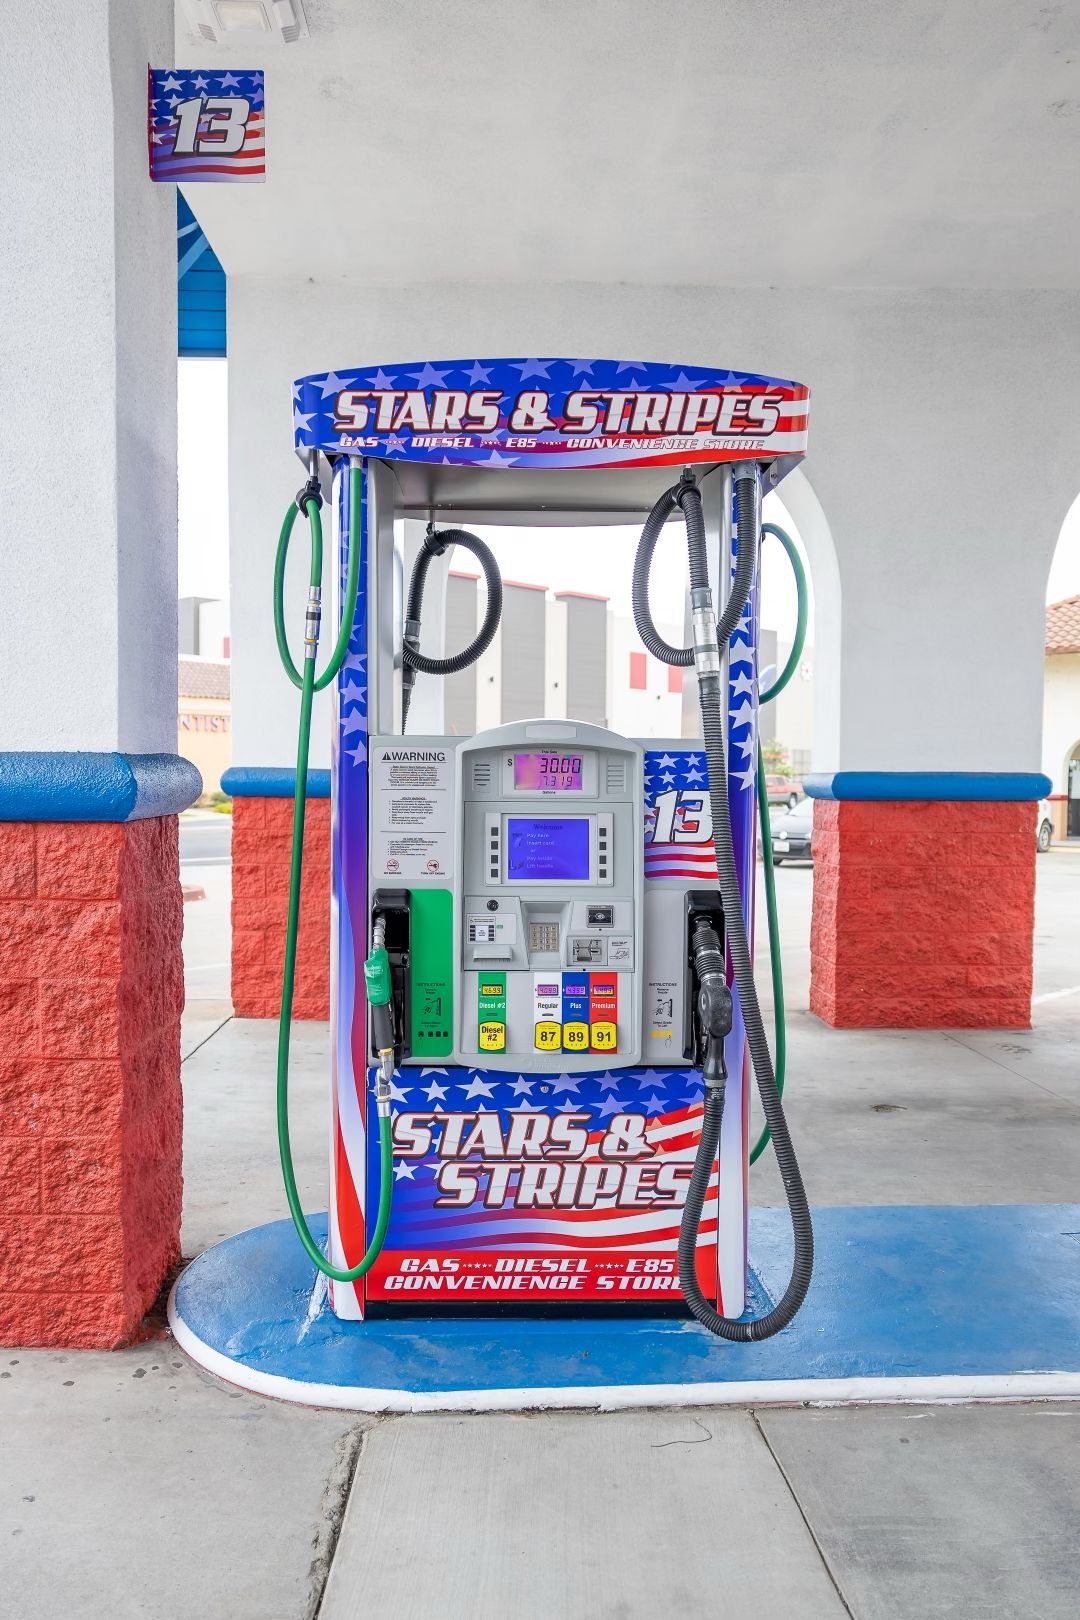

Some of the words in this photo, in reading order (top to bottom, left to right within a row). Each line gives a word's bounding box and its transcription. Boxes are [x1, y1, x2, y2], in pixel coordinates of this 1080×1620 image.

[172, 97, 250, 156] 13
[332, 389, 503, 433] STARS
[508, 390, 557, 434] &
[559, 391, 784, 436] STRIPES
[340, 436, 379, 447] GAS
[411, 437, 474, 448] DIESEL
[506, 437, 537, 448] E85
[566, 438, 698, 449] CONVENIENCE
[703, 439, 765, 450] STORE
[391, 752, 445, 761] WARNING
[540, 758, 581, 773] 30.00
[543, 776, 572, 786] 7.319
[651, 789, 714, 844] 13
[540, 1031, 556, 1042] 87
[569, 1032, 584, 1042] 89
[597, 1032, 611, 1042] 91
[392, 1112, 592, 1160] STARS
[600, 1112, 656, 1158] &
[434, 1161, 695, 1208] STRIPES
[400, 1258, 461, 1272] GAS
[494, 1258, 592, 1272] DIESEL
[626, 1258, 676, 1272] E85
[384, 1276, 588, 1290] CONVENIENCE
